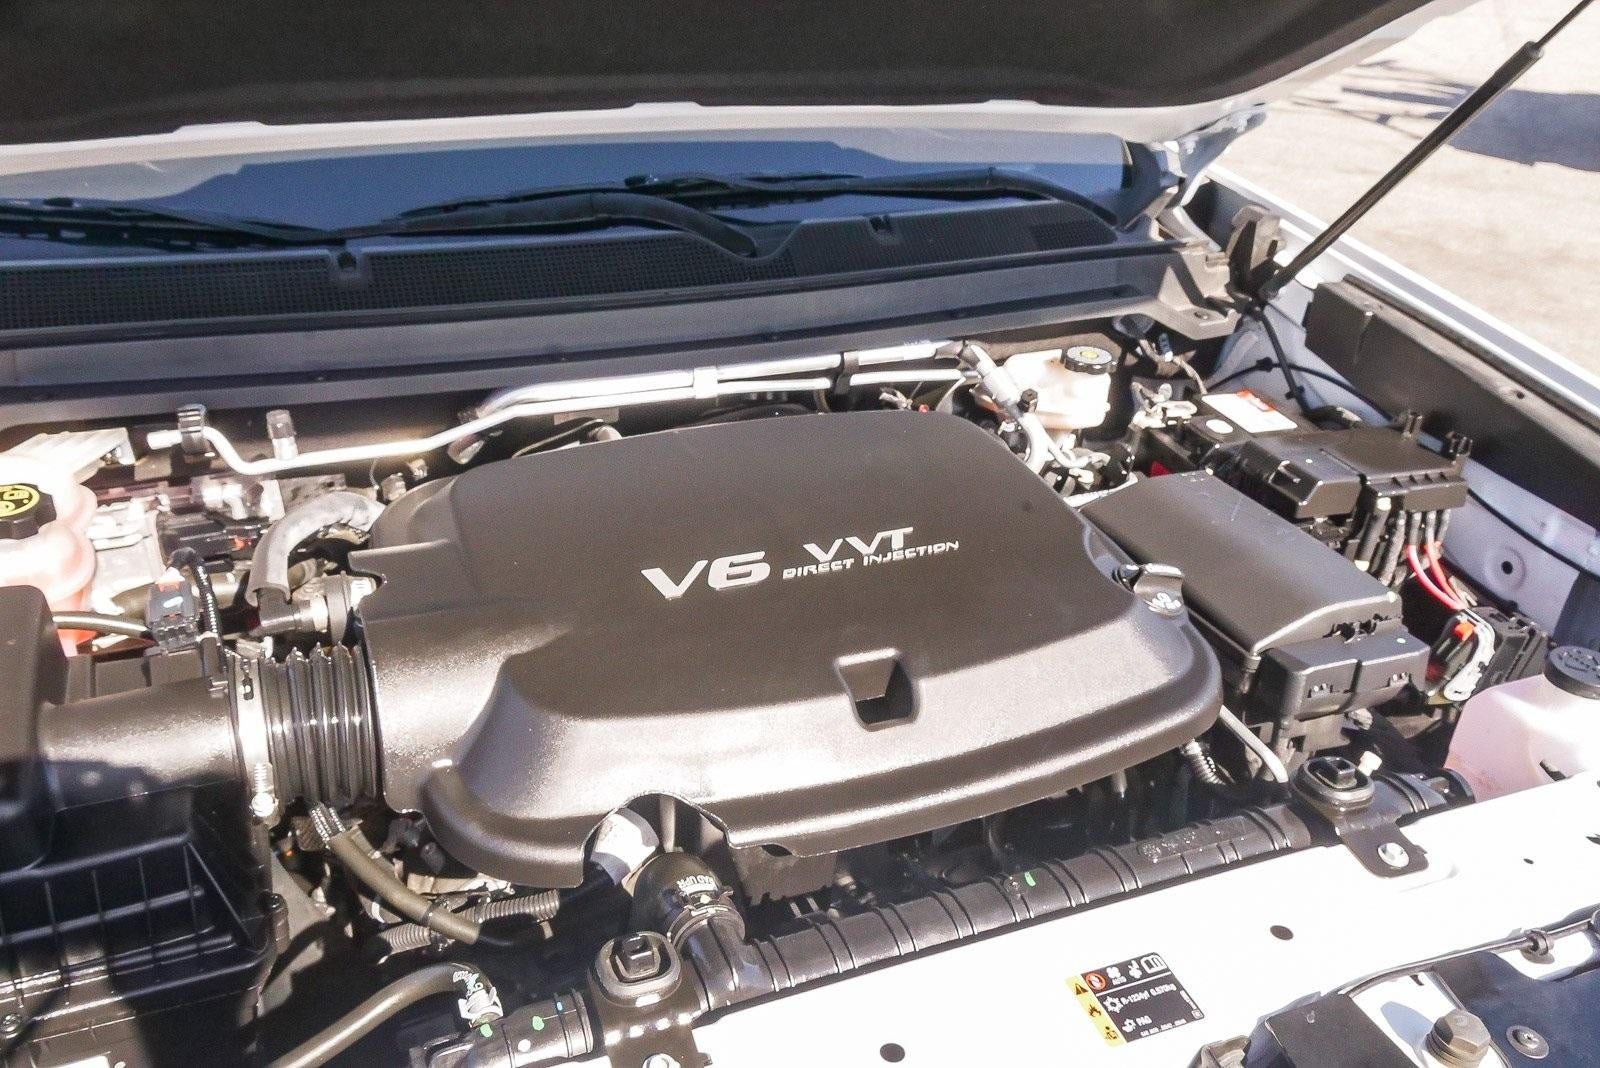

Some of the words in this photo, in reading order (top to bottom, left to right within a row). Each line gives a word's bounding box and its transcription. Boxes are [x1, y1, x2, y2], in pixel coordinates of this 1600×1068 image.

[782, 558, 855, 579] DIRECT
[862, 540, 960, 567] INJECTION
[803, 526, 914, 562] VVT
[640, 551, 771, 600] V6
